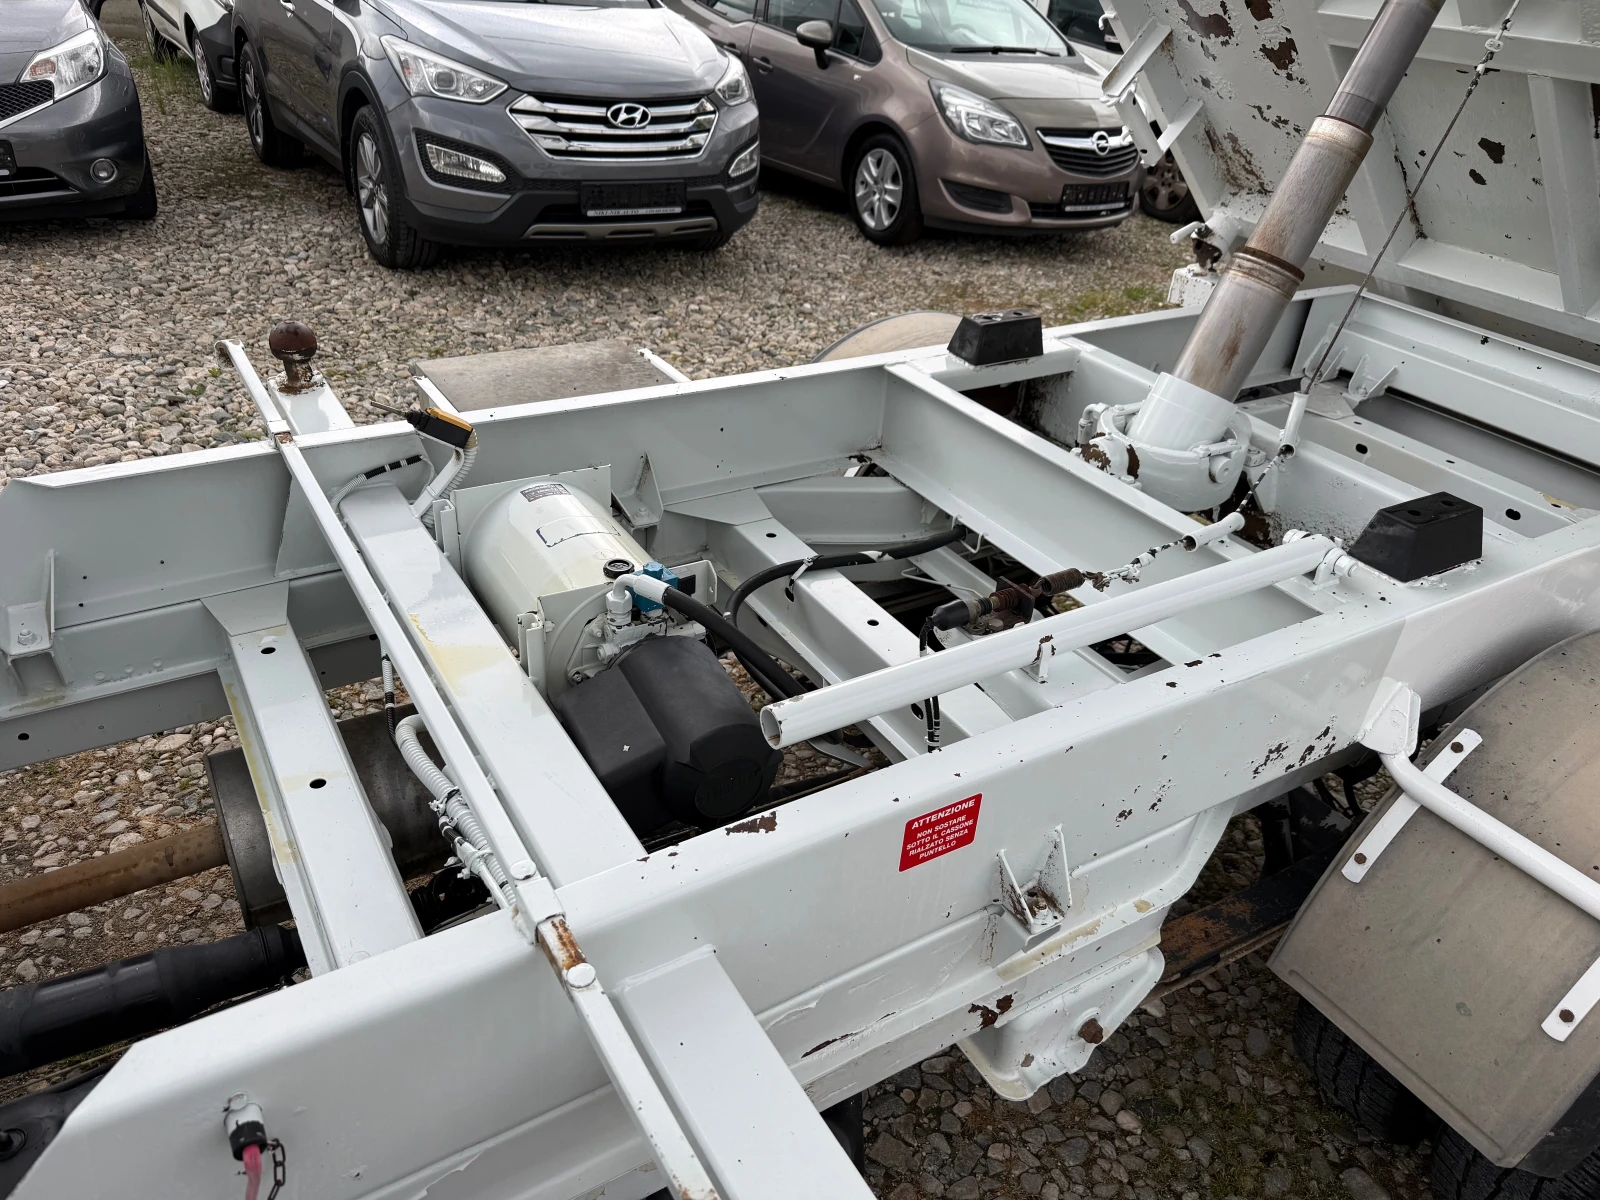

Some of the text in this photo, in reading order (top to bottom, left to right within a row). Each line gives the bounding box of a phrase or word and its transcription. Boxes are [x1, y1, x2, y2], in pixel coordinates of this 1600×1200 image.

[911, 798, 976, 830] ATTENZIONE
[916, 814, 967, 839] NON SOSTARE
[906, 836, 931, 850] SOTTO
[940, 819, 974, 836] CASSONE
[909, 828, 969, 857] RIALZATO SENZA
[919, 840, 957, 860] PUNTELLO
